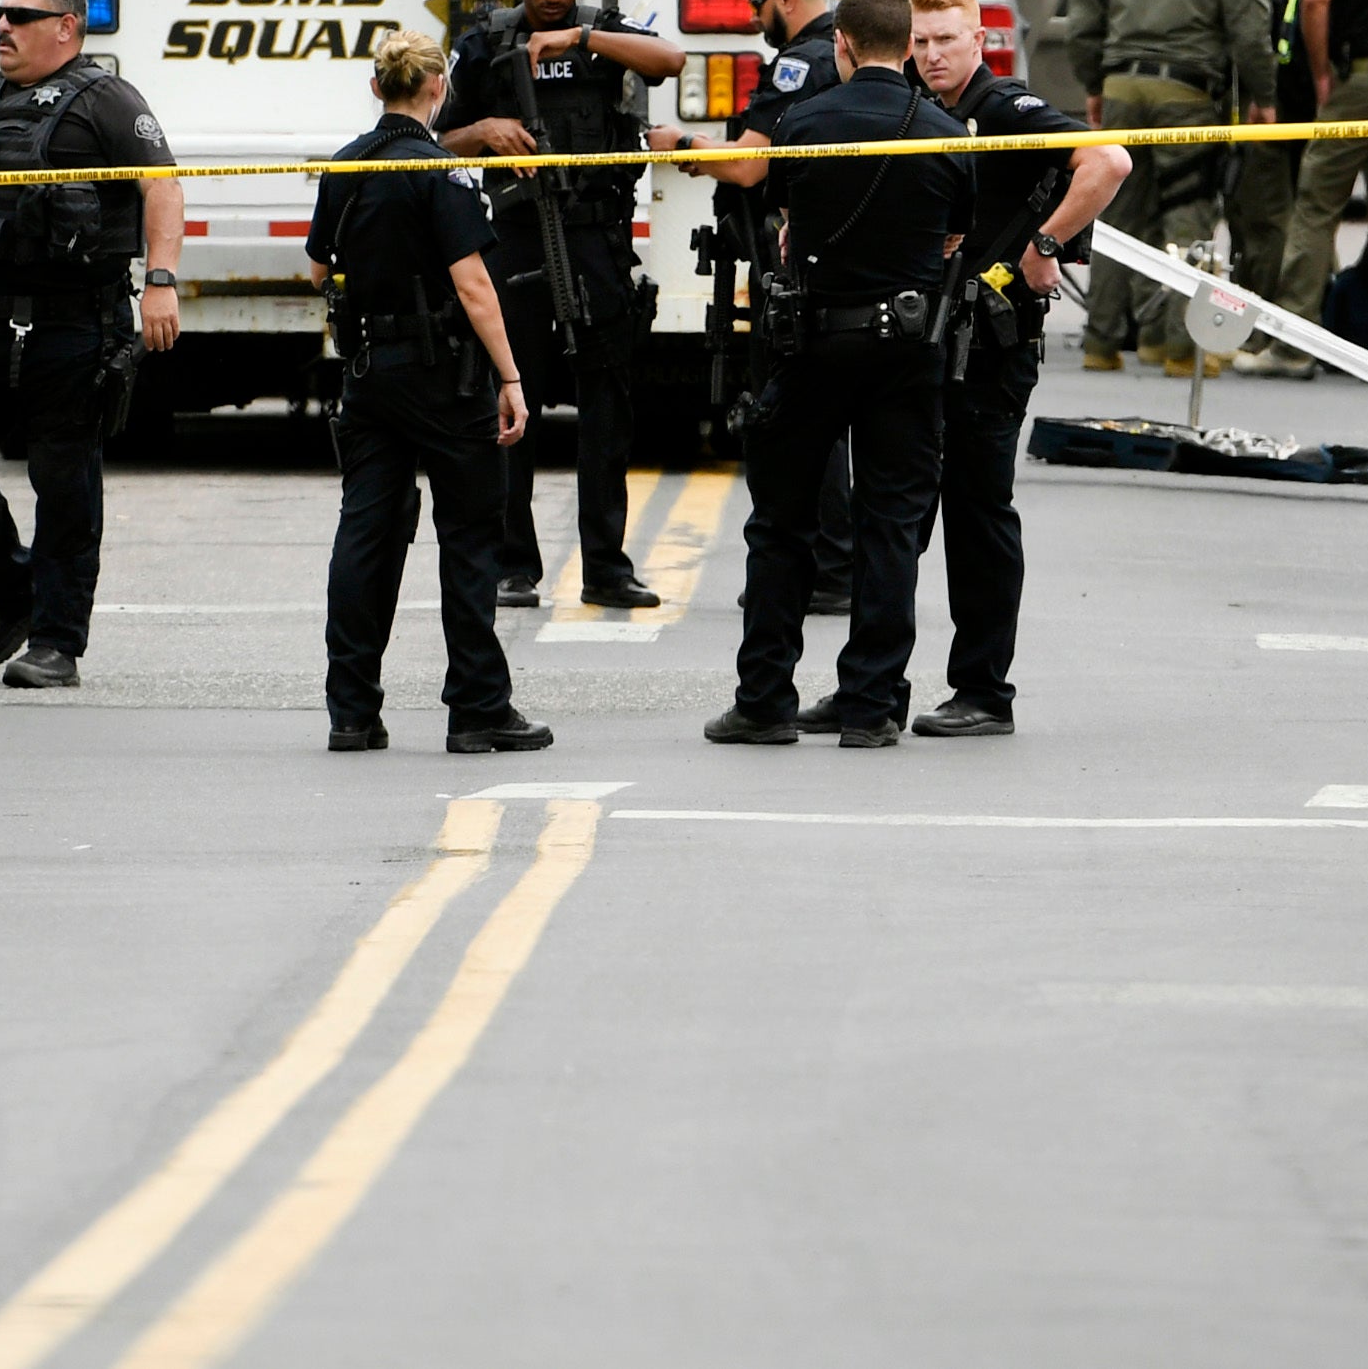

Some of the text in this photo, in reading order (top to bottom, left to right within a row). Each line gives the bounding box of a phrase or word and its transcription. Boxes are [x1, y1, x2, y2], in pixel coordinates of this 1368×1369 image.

[162, 18, 404, 64] SQUAD
[535, 61, 573, 80] OLICE
[1127, 130, 1233, 144] POLICE LINE DO NOT CROSS
[1314, 127, 1340, 138] POLICE
[1343, 126, 1361, 137] LINE
[10, 173, 21, 183] DE
[23, 172, 53, 182] POLICIA
[56, 172, 71, 182] POR
[74, 171, 99, 181] FAVOR
[101, 171, 112, 180] NO
[114, 170, 145, 180] CRUZAR
